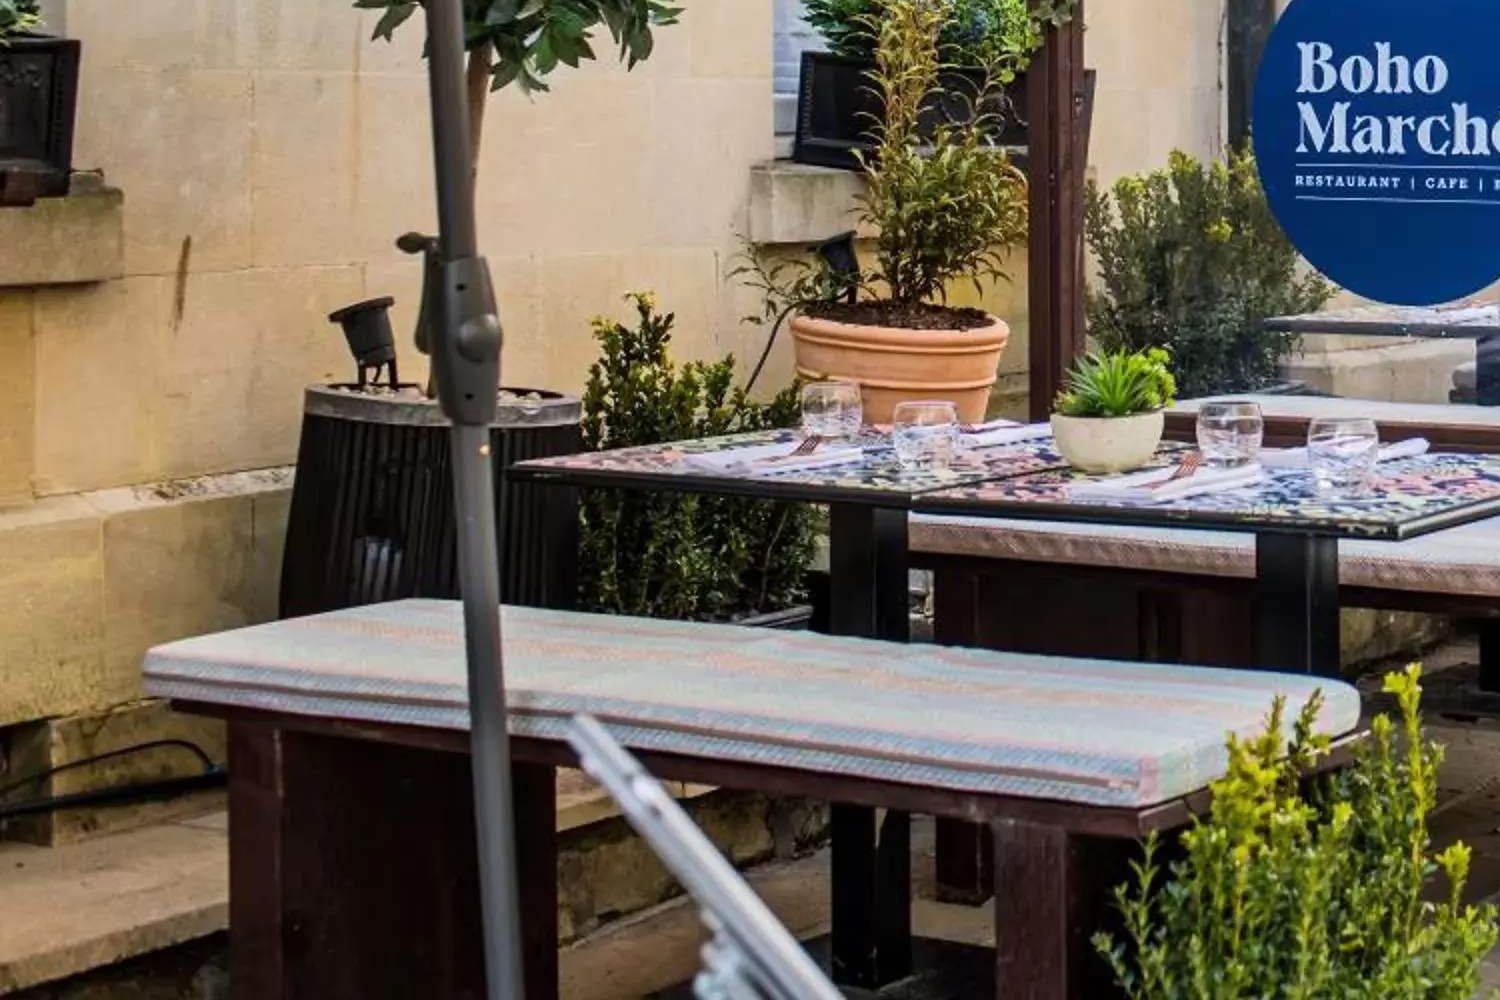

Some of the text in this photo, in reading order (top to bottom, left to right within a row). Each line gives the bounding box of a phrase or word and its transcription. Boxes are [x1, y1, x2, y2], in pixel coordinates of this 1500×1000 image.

[1295, 41, 1449, 94] Boho
[1295, 175, 1401, 188] RESTAURANT
[1425, 177, 1469, 189] CAFE
